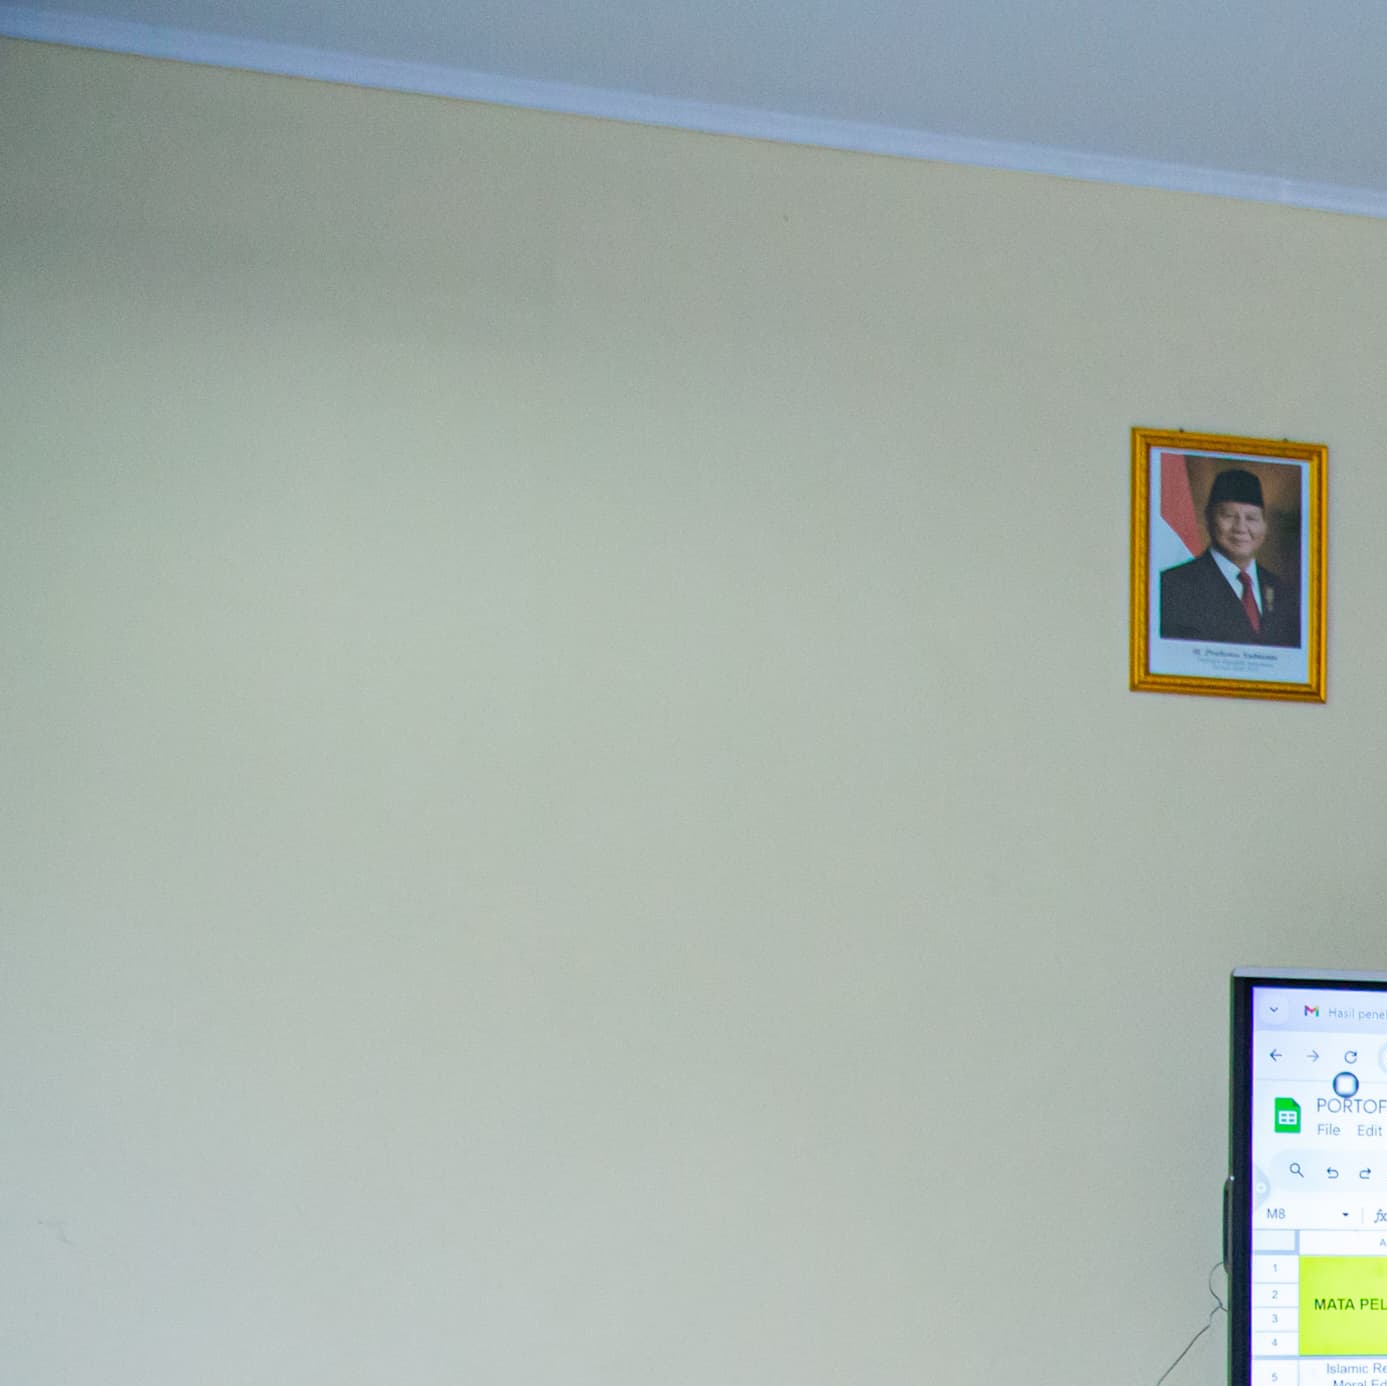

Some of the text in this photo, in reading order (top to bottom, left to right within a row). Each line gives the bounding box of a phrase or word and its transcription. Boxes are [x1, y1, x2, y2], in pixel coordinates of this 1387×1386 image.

[1328, 1008, 1355, 1019] Hasil
[1317, 1124, 1340, 1137] File
[1357, 1124, 1382, 1138] Edit
[1267, 1209, 1286, 1220] M8
[1314, 1299, 1355, 1311] MATA
[1326, 1363, 1368, 1374] Islamic
